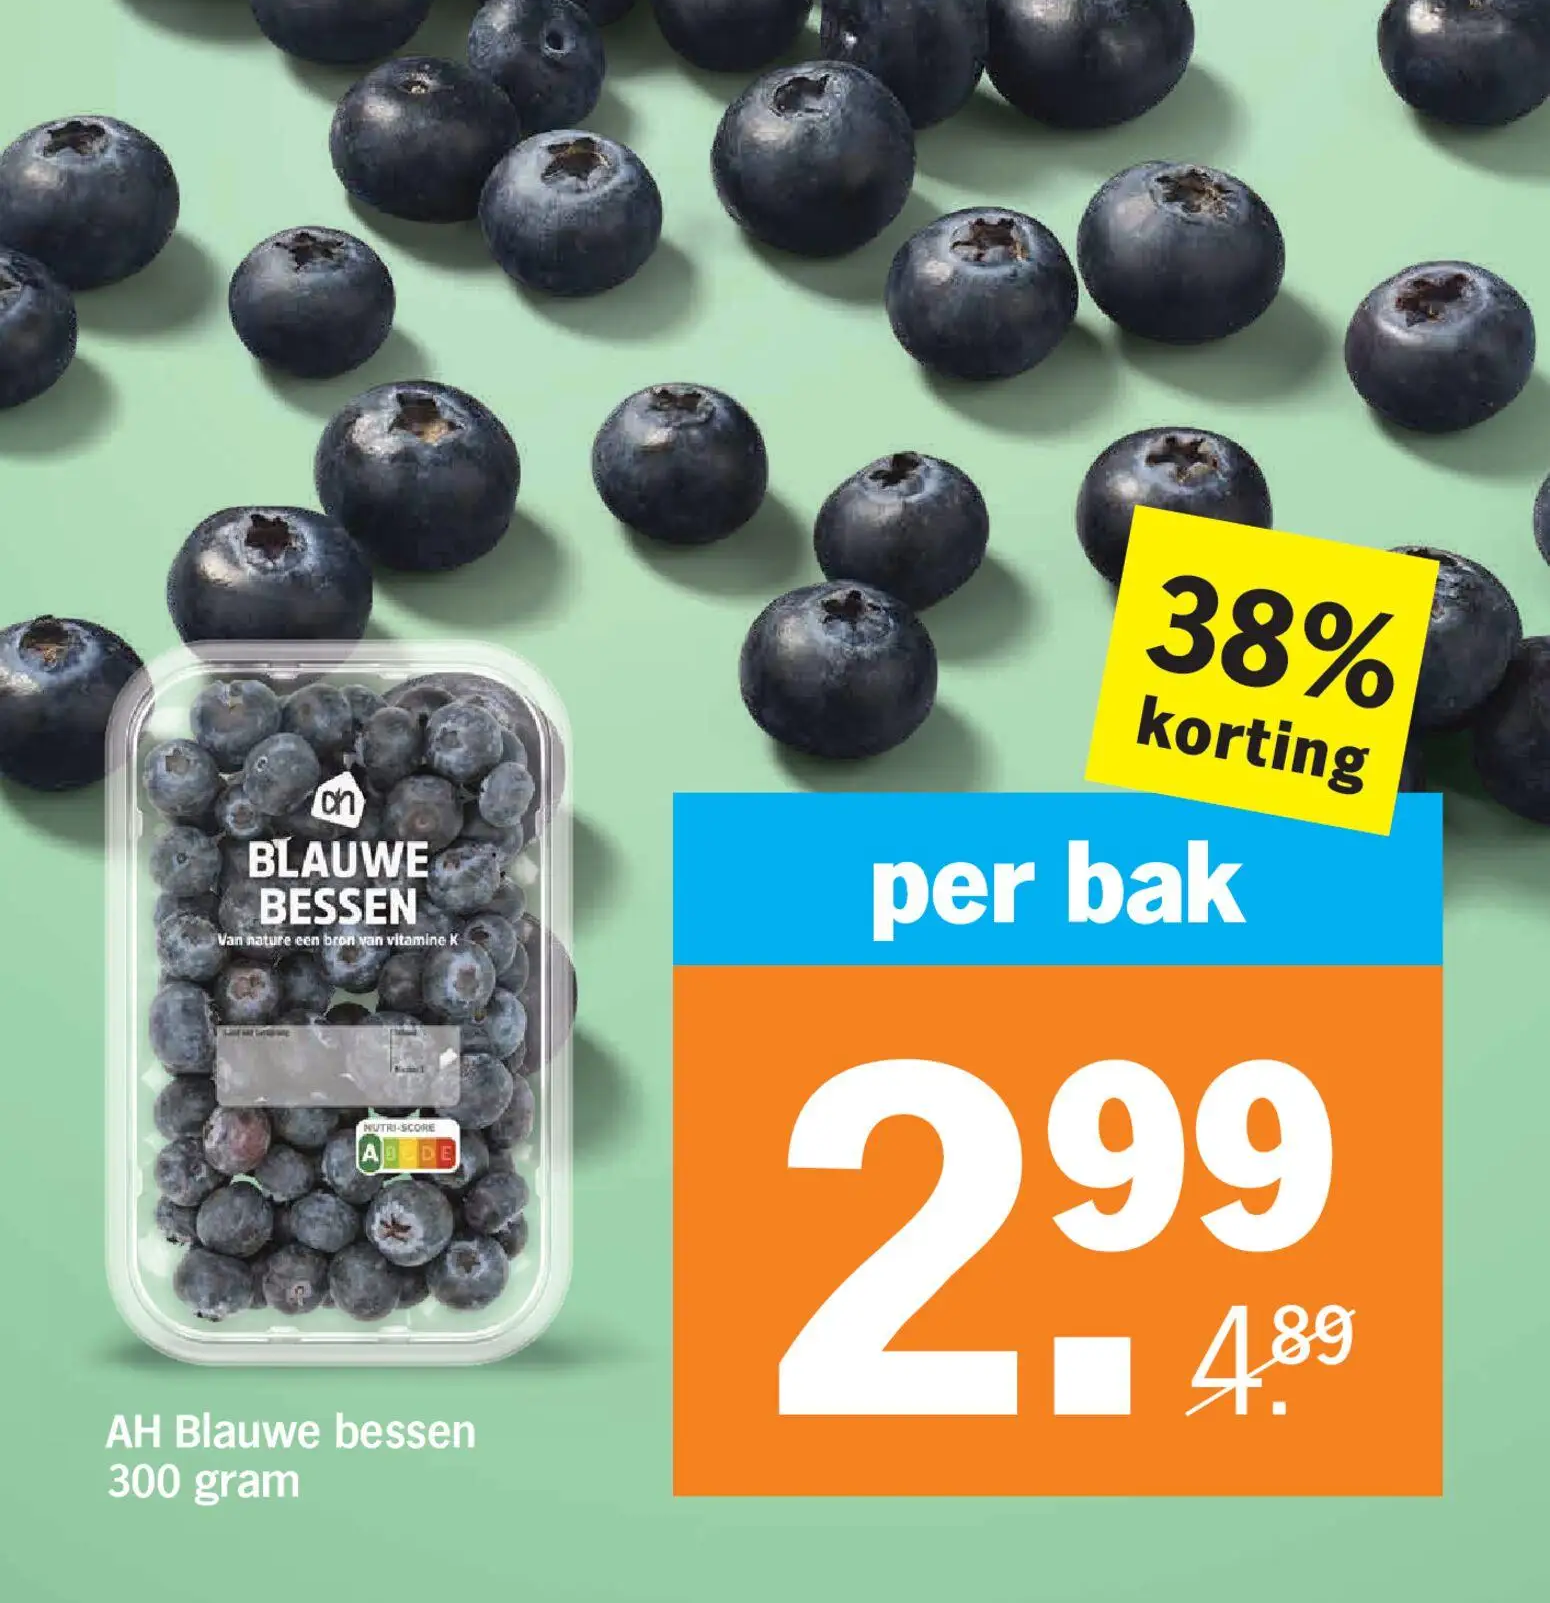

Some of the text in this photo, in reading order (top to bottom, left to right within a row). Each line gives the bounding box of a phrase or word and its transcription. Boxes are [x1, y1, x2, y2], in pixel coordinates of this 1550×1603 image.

[1145, 574, 1395, 709] 38%
[1136, 694, 1370, 795] korting
[249, 840, 429, 878] BLAUWE
[260, 888, 416, 925] BESSEN
[872, 839, 1247, 942] per bak
[217, 932, 458, 946] Van nature een bron van vitamine K
[778, 1058, 1334, 1416] 2.99
[105, 1411, 476, 1450] AH Blauwe bessen
[107, 1463, 300, 1507] 300 gram
